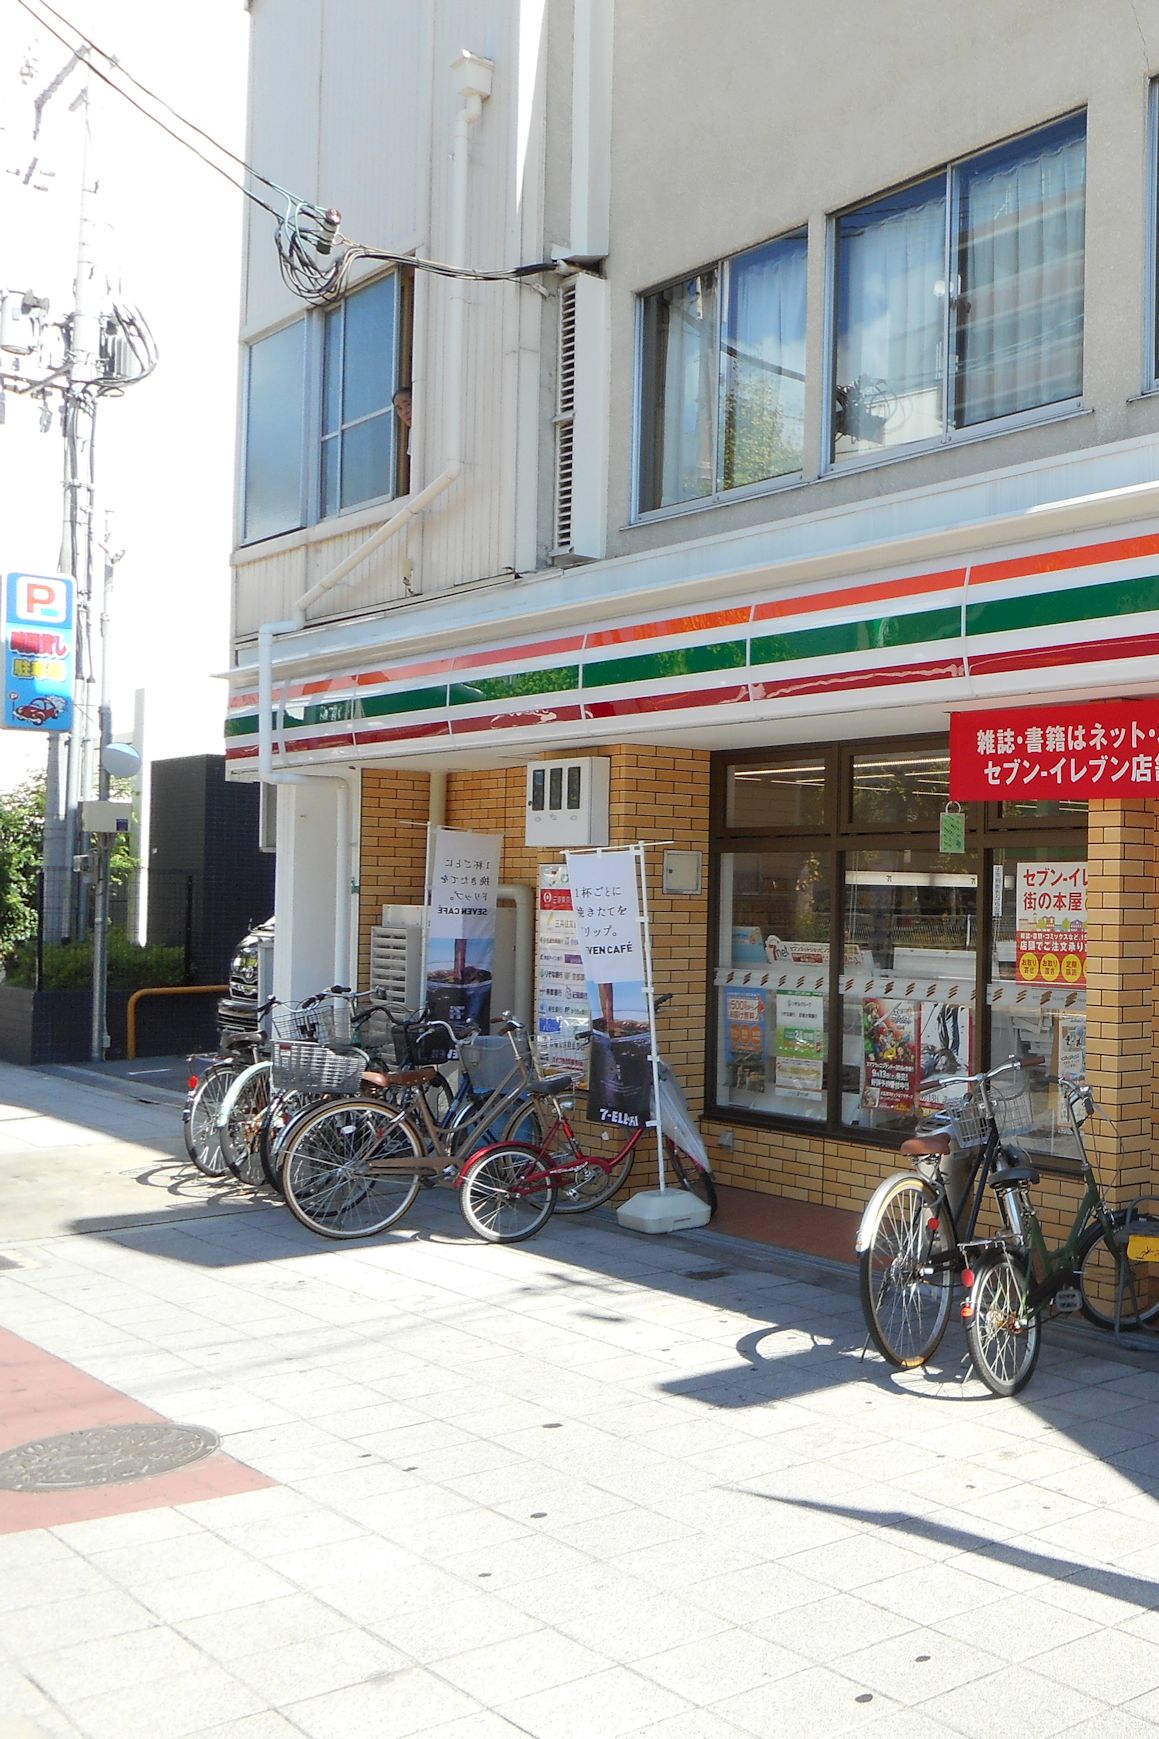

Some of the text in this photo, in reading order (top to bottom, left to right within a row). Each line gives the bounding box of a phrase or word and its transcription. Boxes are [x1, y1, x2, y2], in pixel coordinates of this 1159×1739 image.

[27, 583, 56, 613] P
[1023, 891, 1087, 911] 街の本屋
